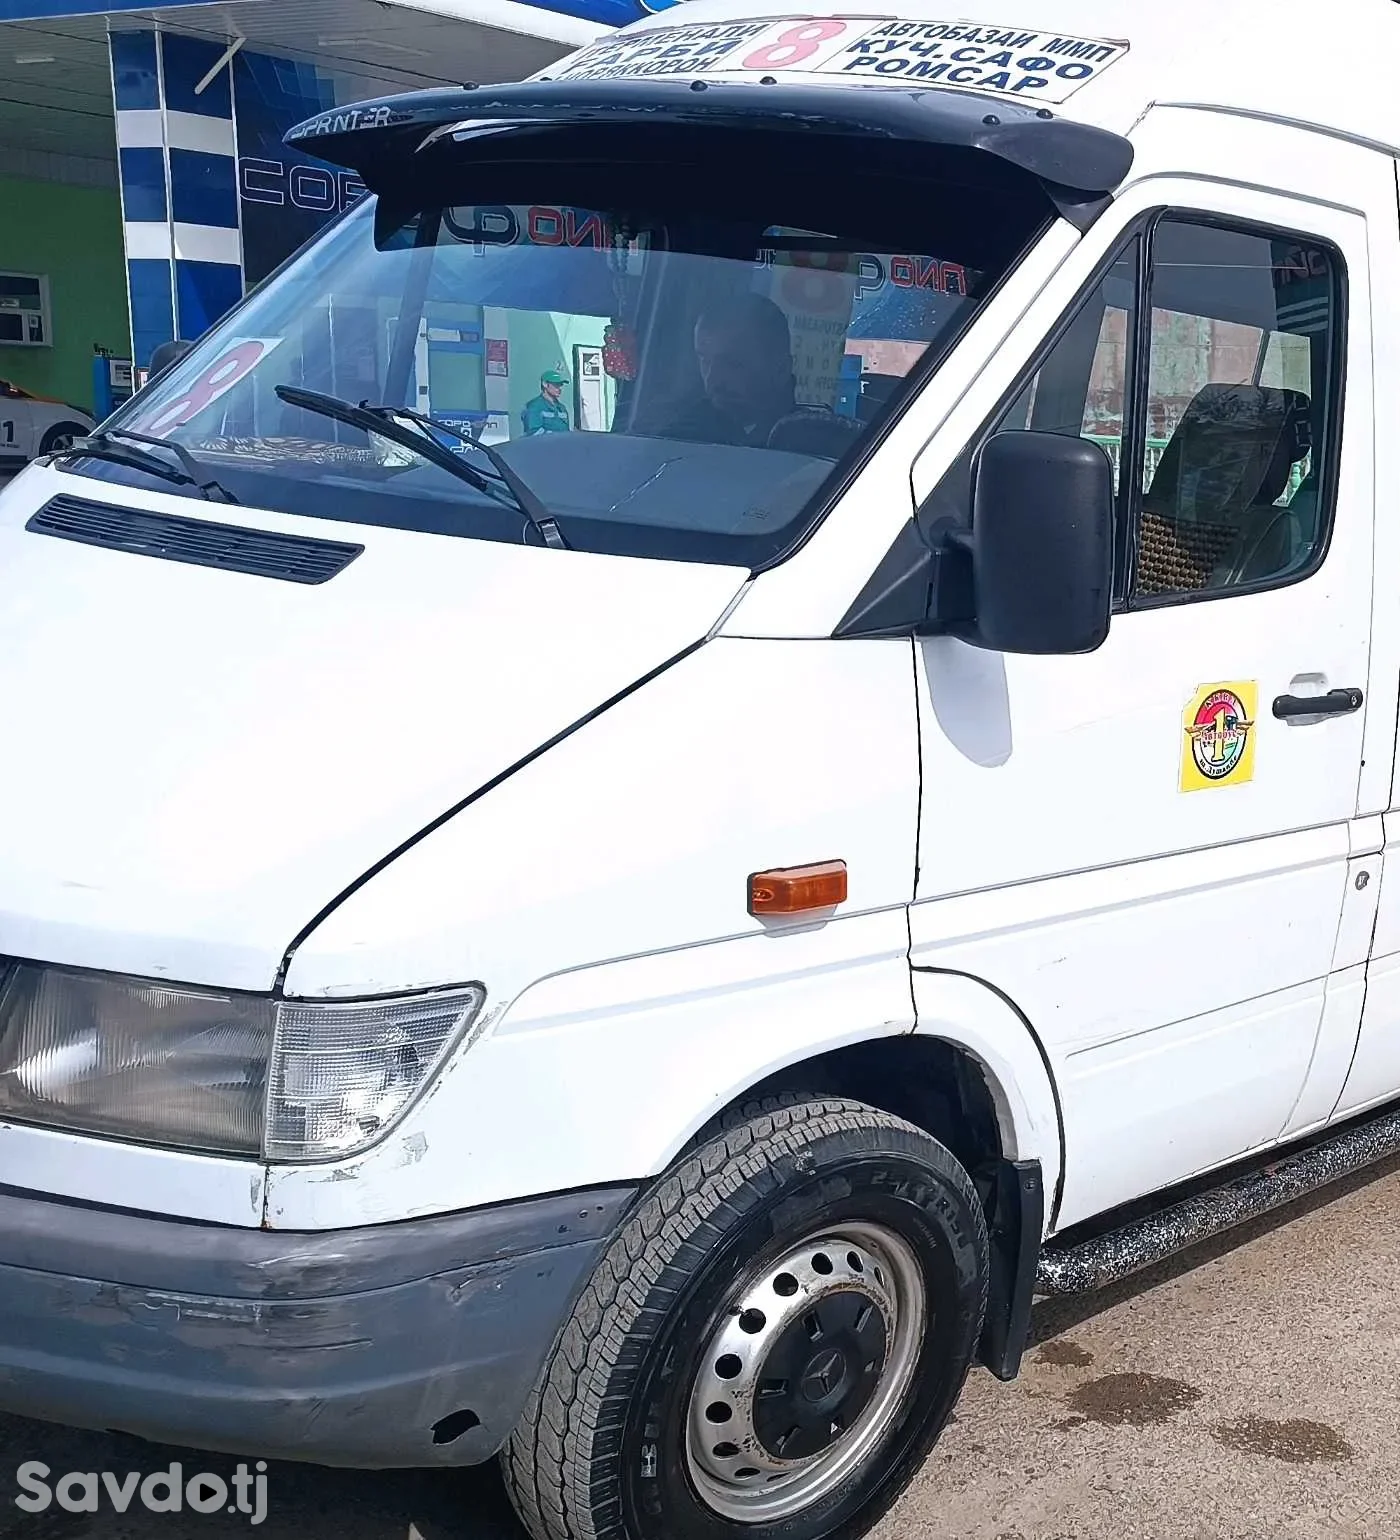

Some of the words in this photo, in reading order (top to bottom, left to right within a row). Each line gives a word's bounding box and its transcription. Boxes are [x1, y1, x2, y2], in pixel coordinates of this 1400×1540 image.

[742, 22, 847, 68] 8
[1040, 37, 1118, 62] ММП
[842, 56, 1049, 92] РОМСАР
